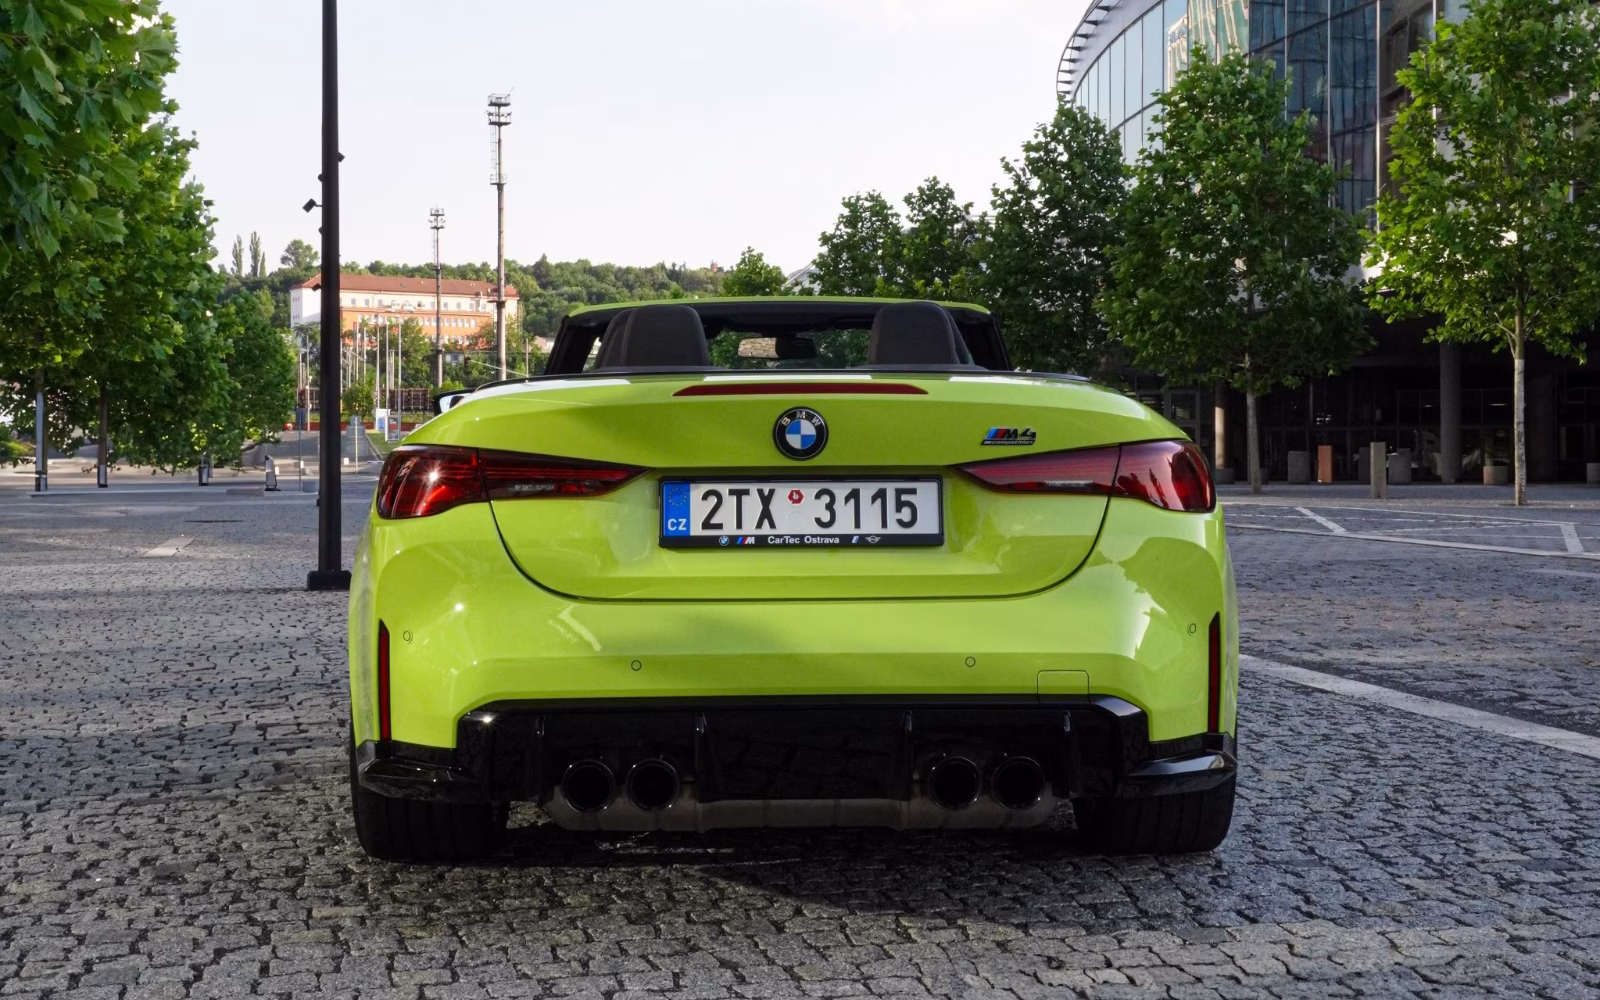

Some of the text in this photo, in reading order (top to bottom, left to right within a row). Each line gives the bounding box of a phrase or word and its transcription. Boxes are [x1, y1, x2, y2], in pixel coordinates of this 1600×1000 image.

[780, 410, 822, 427] BMW
[700, 487, 918, 530] 2TX 3115
[667, 518, 687, 531] CZ
[767, 535, 840, 544] CarTec Ostrava
